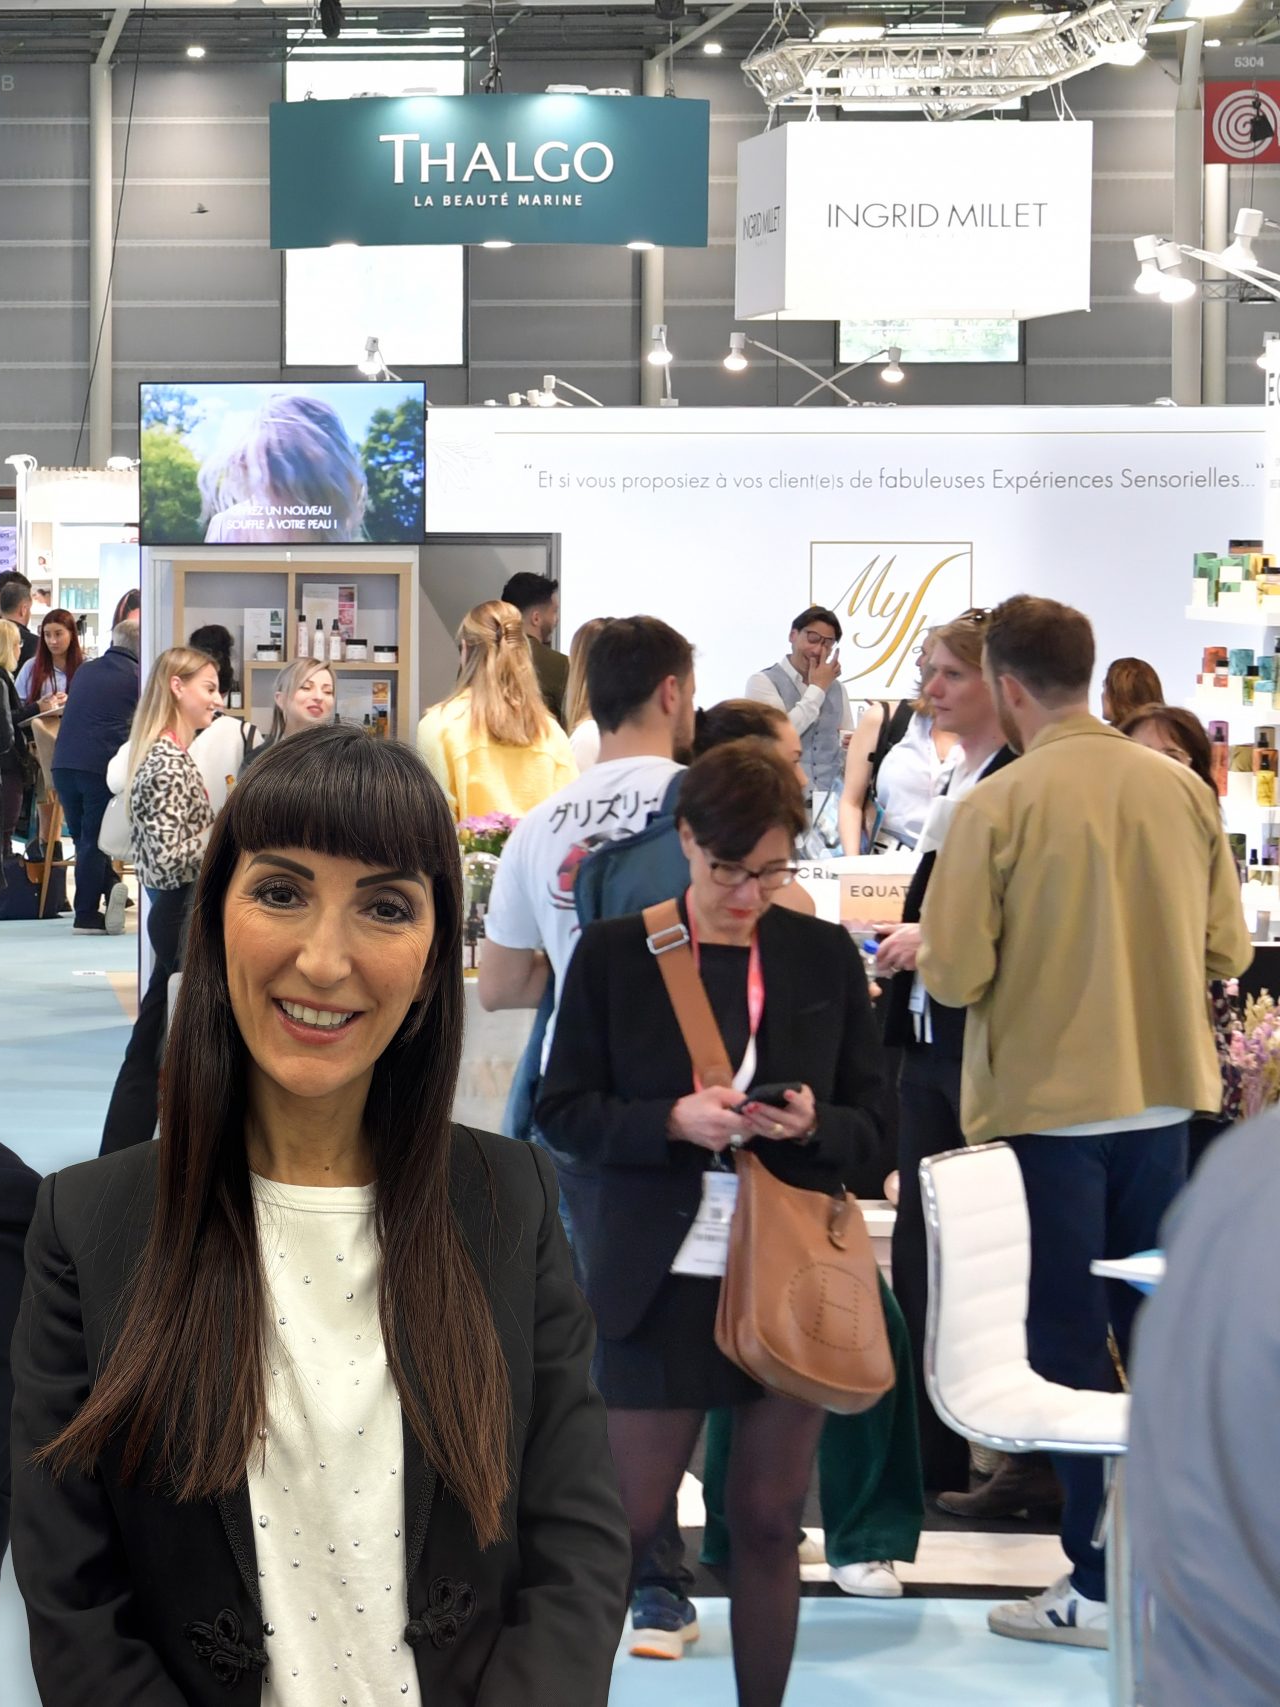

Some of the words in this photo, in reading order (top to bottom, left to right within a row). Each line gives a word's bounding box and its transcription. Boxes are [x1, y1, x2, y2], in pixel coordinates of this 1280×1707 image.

[1, 75, 15, 91] B
[378, 133, 615, 184] THALGO
[413, 194, 434, 207] LA
[442, 192, 510, 207] BEAUTÉ
[517, 193, 583, 206] MARINE
[827, 202, 940, 229] INGRID
[947, 202, 1049, 229] MILLET
[538, 471, 554, 489] Et
[559, 470, 571, 489] si
[576, 475, 616, 489] vous
[622, 471, 710, 494] proposiez
[715, 471, 727, 489] à
[733, 475, 763, 489] vos
[849, 470, 873, 489] de
[879, 467, 985, 489] fabuleuses
[992, 469, 1113, 494] Expériences
[265, 505, 281, 516] UN
[283, 505, 332, 516] NOUVEAU
[266, 518, 275, 530] À
[276, 519, 305, 530] VOTRE
[308, 519, 332, 530] PEAU
